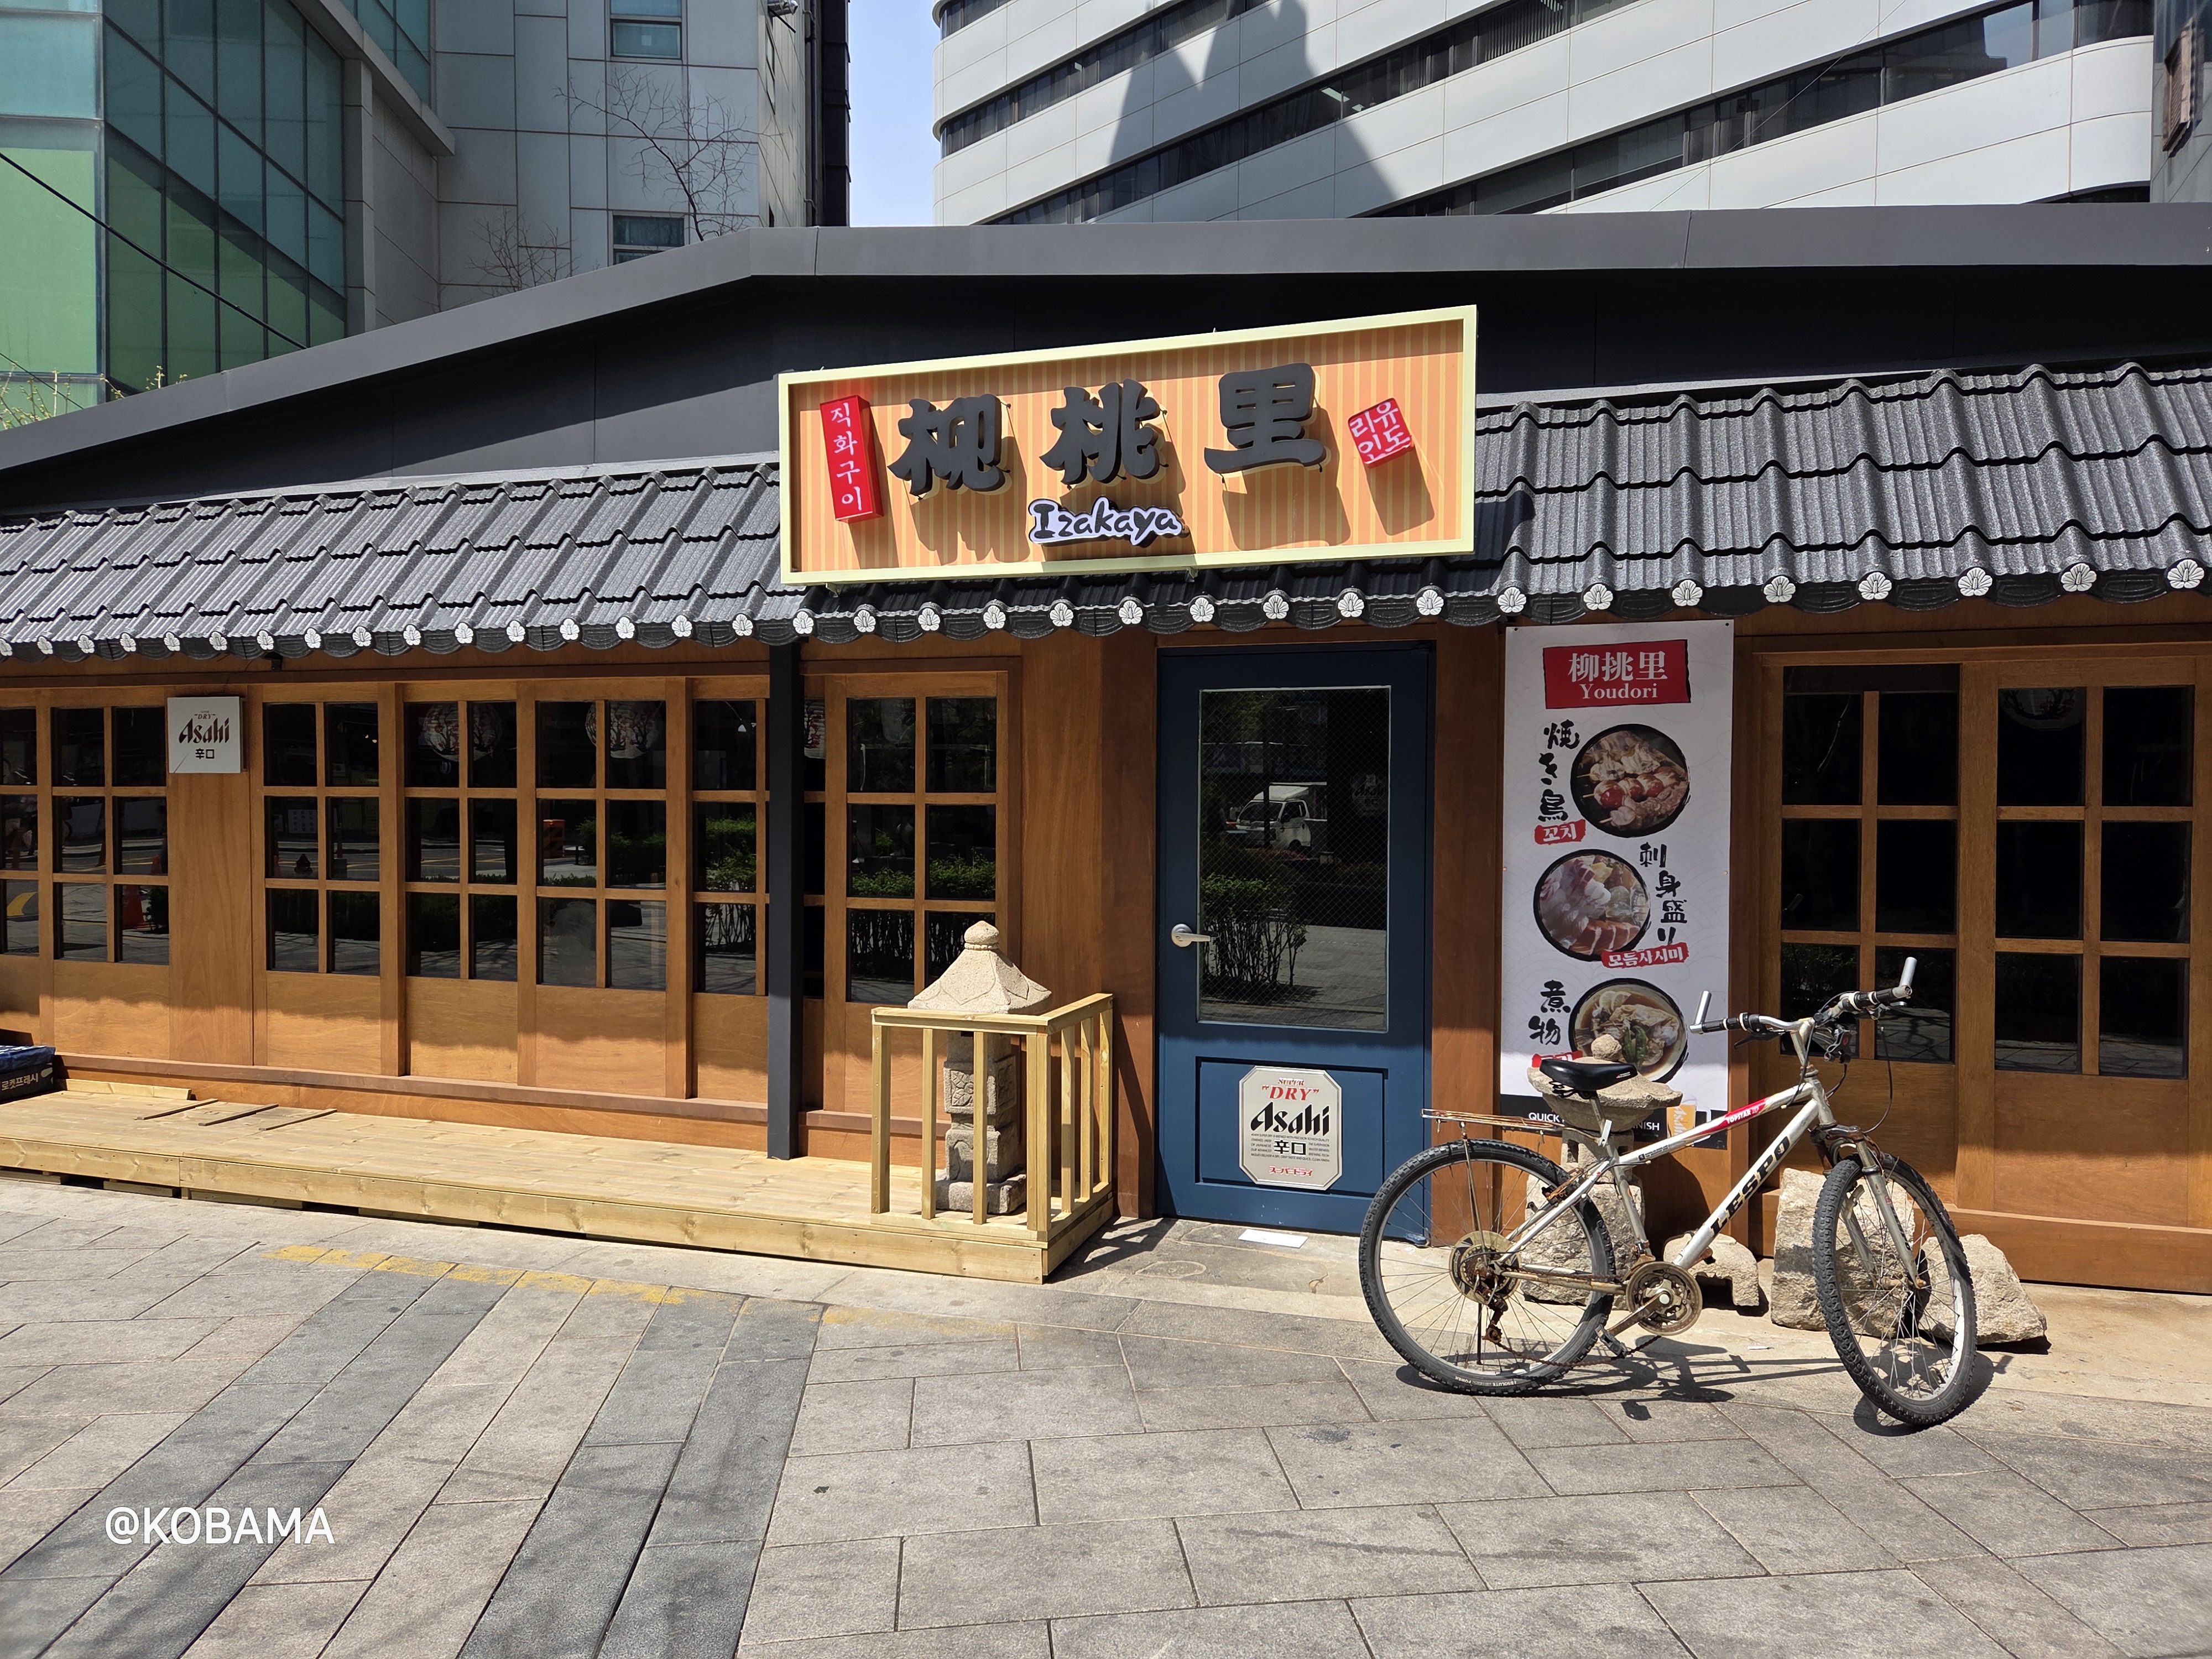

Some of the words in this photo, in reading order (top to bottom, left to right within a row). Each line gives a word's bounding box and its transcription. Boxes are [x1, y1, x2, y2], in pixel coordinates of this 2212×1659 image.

[830, 402, 862, 511] 직화구이
[1032, 499, 1180, 542] Izakaya
[1579, 682, 1658, 699] Youdori
[179, 718, 229, 744] Asahi
[195, 748, 215, 759] 辛口
[1543, 823, 1577, 842] 꼬치
[1608, 947, 1683, 967] 모듬사시미
[1528, 980, 1572, 1045] 煮物
[1, 1073, 39, 1091] 로켓프레시
[1250, 1102, 1329, 1136] Asahi
[1528, 1112, 1561, 1123] QUICK
[1274, 1140, 1306, 1155] 辛口
[1710, 1136, 1790, 1235] LESPO
